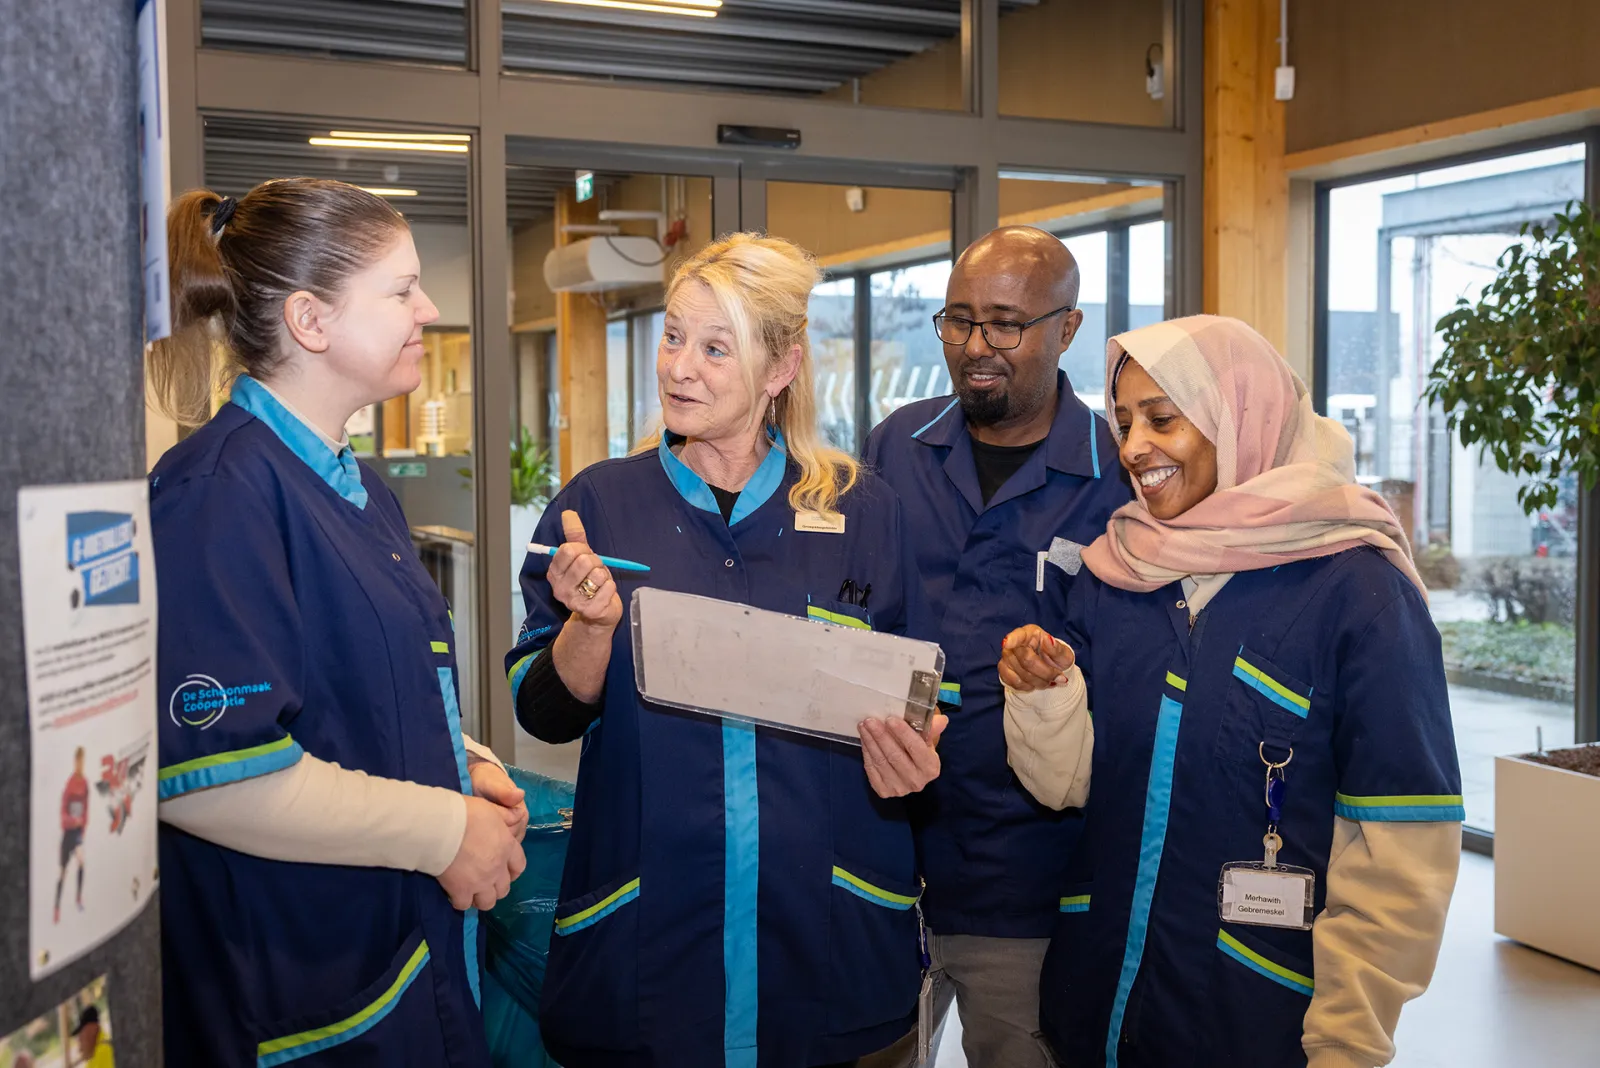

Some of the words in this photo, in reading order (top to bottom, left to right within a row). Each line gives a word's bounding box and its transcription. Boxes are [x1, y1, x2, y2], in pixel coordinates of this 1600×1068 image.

[182, 692, 197, 702] De
[198, 682, 272, 699] Schoonmaak
[1245, 893, 1281, 904] Merhawith
[1237, 905, 1285, 916] Gebremeskel
